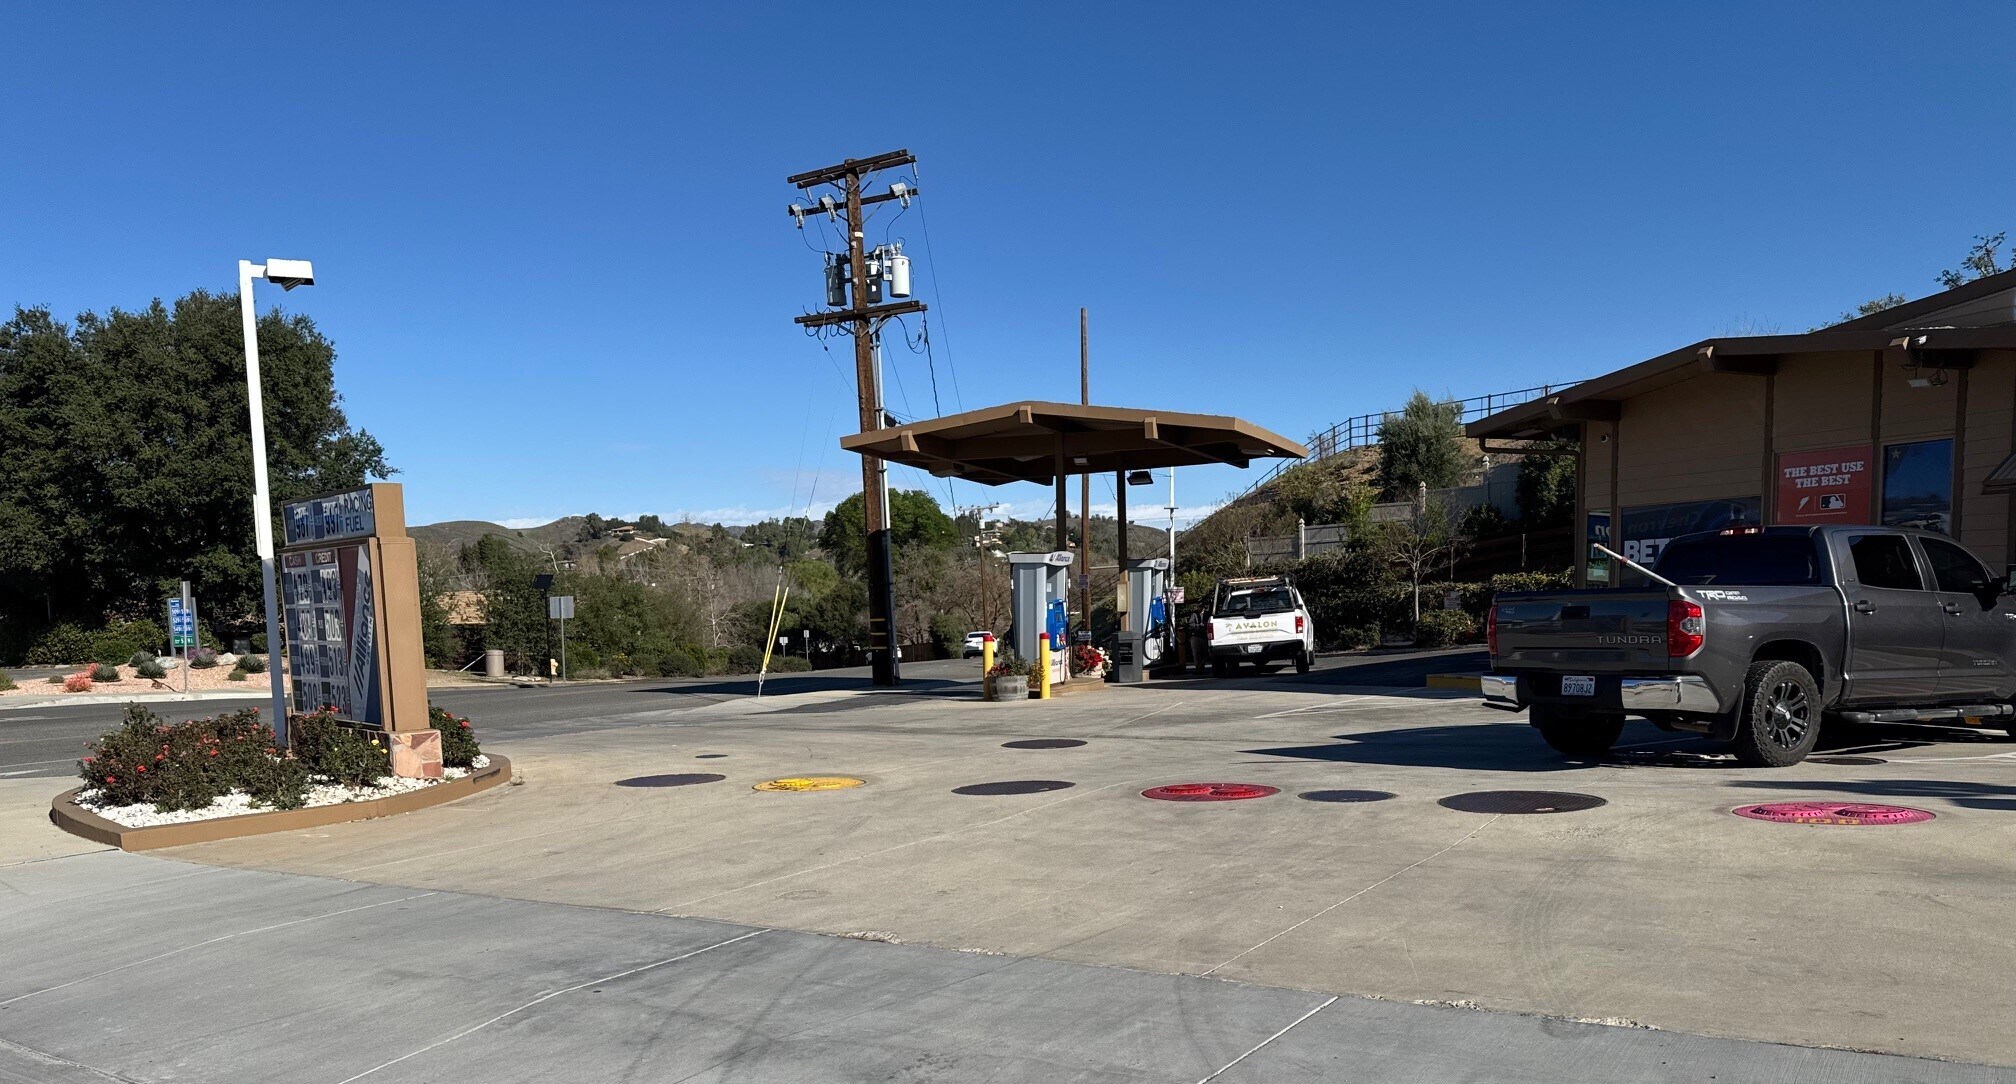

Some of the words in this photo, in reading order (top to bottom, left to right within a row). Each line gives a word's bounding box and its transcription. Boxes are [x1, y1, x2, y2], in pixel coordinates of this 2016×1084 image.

[1785, 467, 1807, 478] THE
[1810, 463, 1839, 475] BEST
[1841, 461, 1864, 472] USE
[1796, 477, 1818, 488] THE
[1821, 474, 1850, 486] BEST
[343, 494, 371, 514] RACING
[345, 516, 364, 532] FUEL
[315, 552, 332, 564] CREDIT
[1624, 538, 1675, 563] BET
[288, 556, 302, 566] CASH
[1696, 590, 1726, 600] TRD
[355, 570, 371, 672] Alliance
[1236, 621, 1278, 630] AVALON
[1597, 635, 1662, 644] TUNDRA
[327, 646, 344, 677] 513
